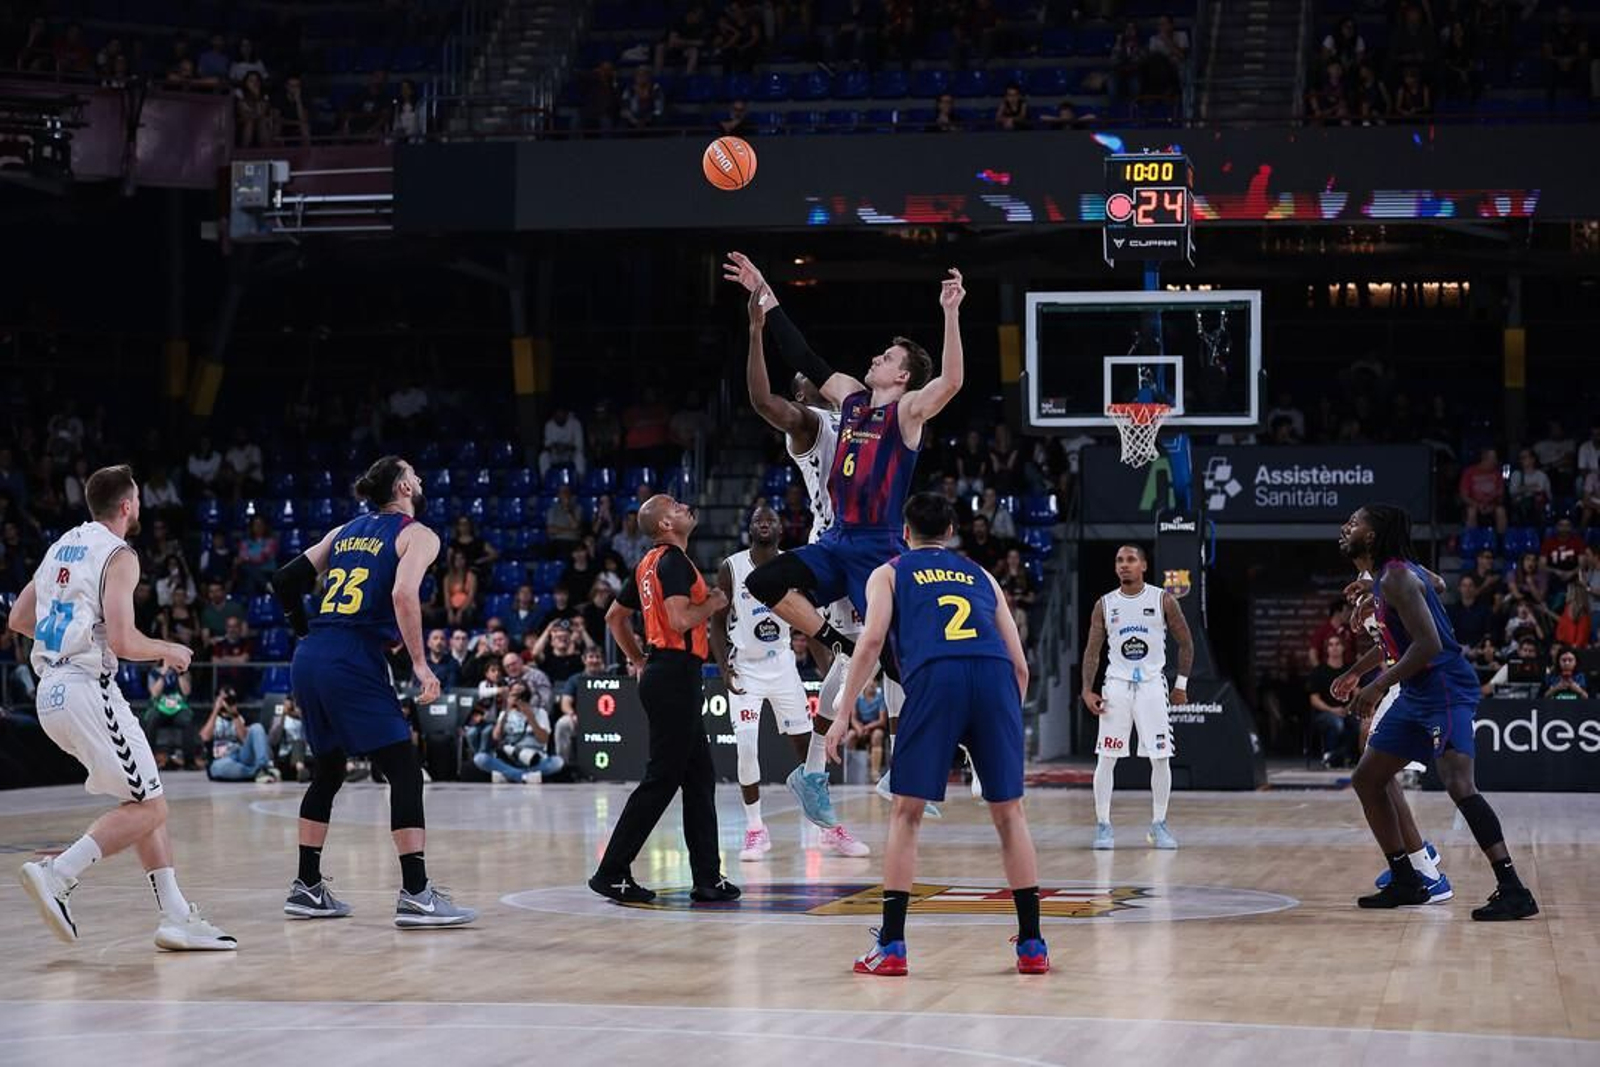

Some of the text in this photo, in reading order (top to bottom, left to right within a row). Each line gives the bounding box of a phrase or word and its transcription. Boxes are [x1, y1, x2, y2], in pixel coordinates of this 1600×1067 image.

[1125, 162, 1174, 182] 10:00
[1137, 190, 1184, 224] 24
[1129, 239, 1178, 247] CUPRA
[843, 453, 855, 477] 6
[1255, 464, 1375, 485] Assistència
[912, 568, 974, 586] MARCOS
[320, 566, 370, 615] 23
[937, 594, 978, 641] 2
[597, 693, 615, 716] 0
[595, 751, 609, 769] 0
